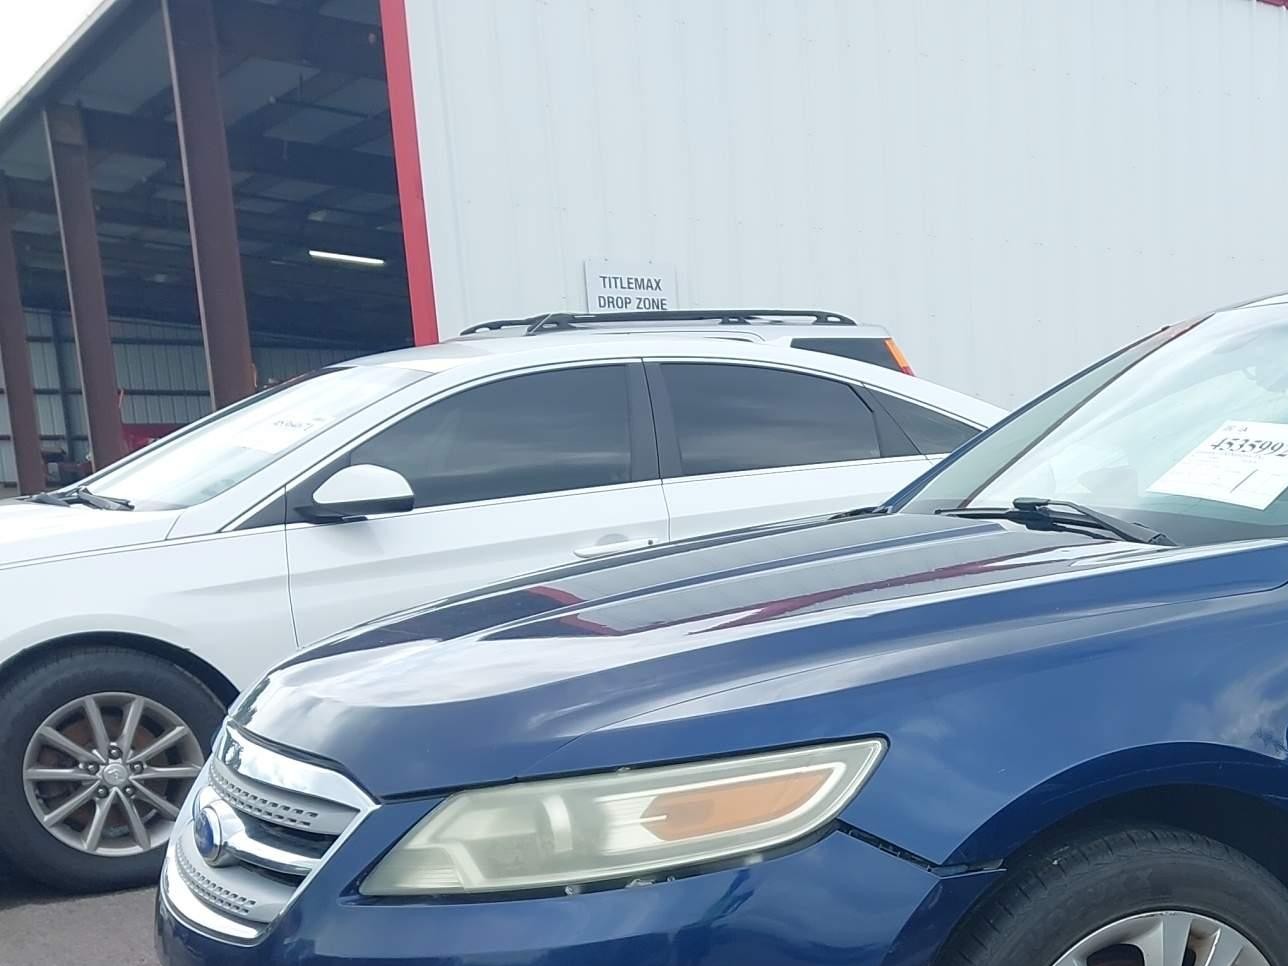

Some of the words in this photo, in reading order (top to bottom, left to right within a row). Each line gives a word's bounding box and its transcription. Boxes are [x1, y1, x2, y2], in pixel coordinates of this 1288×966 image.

[599, 275, 663, 291] TITLEMAX
[598, 295, 632, 309] DROP
[636, 297, 668, 310] ZONE
